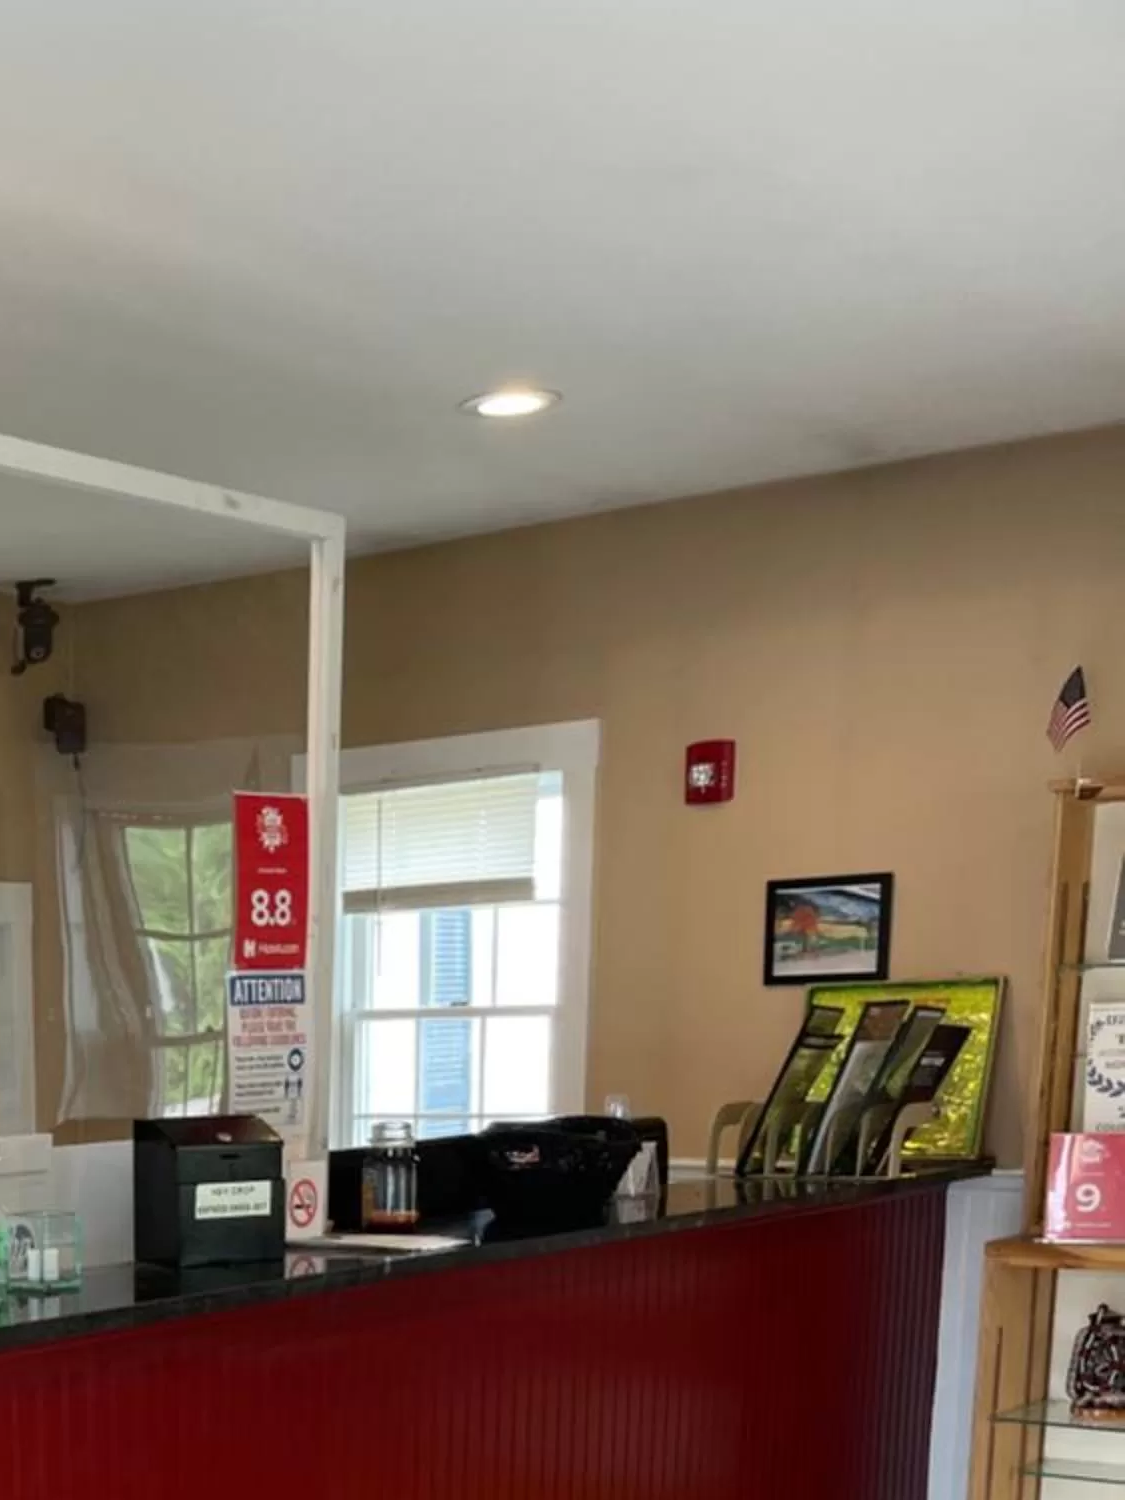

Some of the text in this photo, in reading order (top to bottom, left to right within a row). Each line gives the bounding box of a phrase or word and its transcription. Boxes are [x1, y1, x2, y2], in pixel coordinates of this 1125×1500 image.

[251, 888, 292, 928] 8.8
[233, 977, 302, 1002] ATTENTION
[1076, 1183, 1101, 1213] 9
